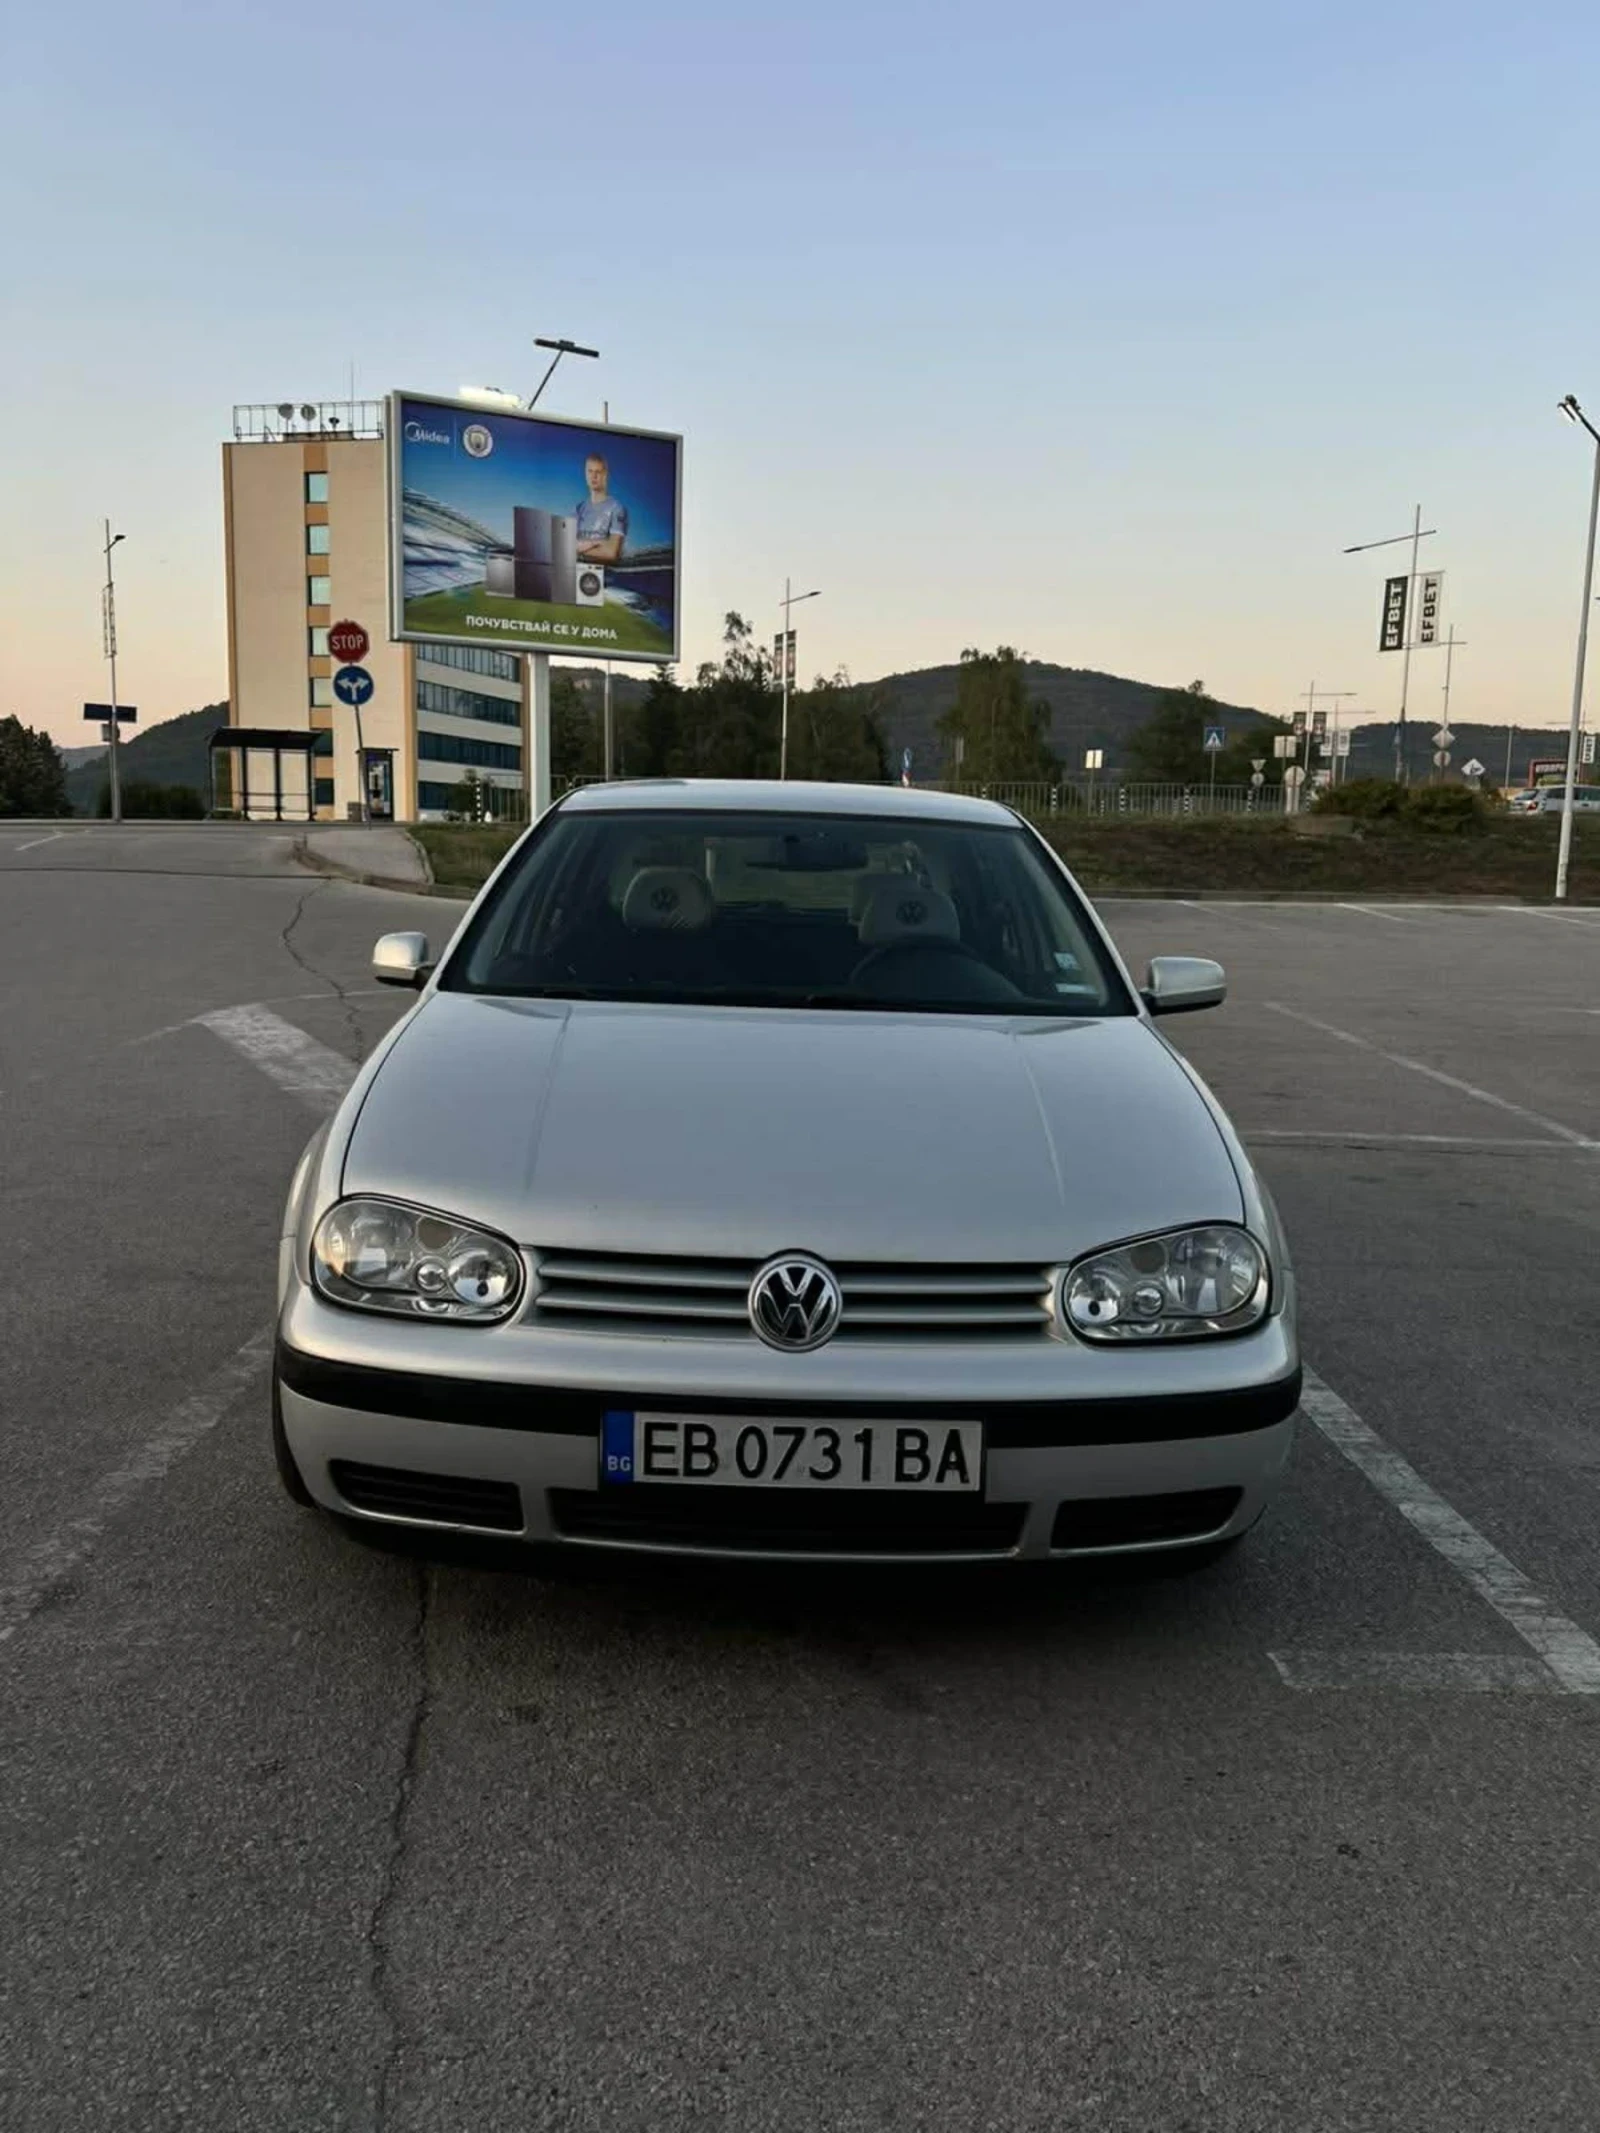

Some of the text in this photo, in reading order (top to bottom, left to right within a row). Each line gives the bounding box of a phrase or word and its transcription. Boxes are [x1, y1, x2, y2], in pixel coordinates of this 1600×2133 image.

[409, 425, 450, 445] Midea
[465, 615, 617, 639] ПОЧУВСТВАЙ СЕ У ДОМА
[1385, 583, 1404, 647] EFBET
[1421, 579, 1439, 643] EFBET
[331, 635, 365, 651] STOP
[755, 1262, 837, 1343] VW
[607, 1455, 631, 1472] BG
[643, 1421, 970, 1484] EB 0731 BA
